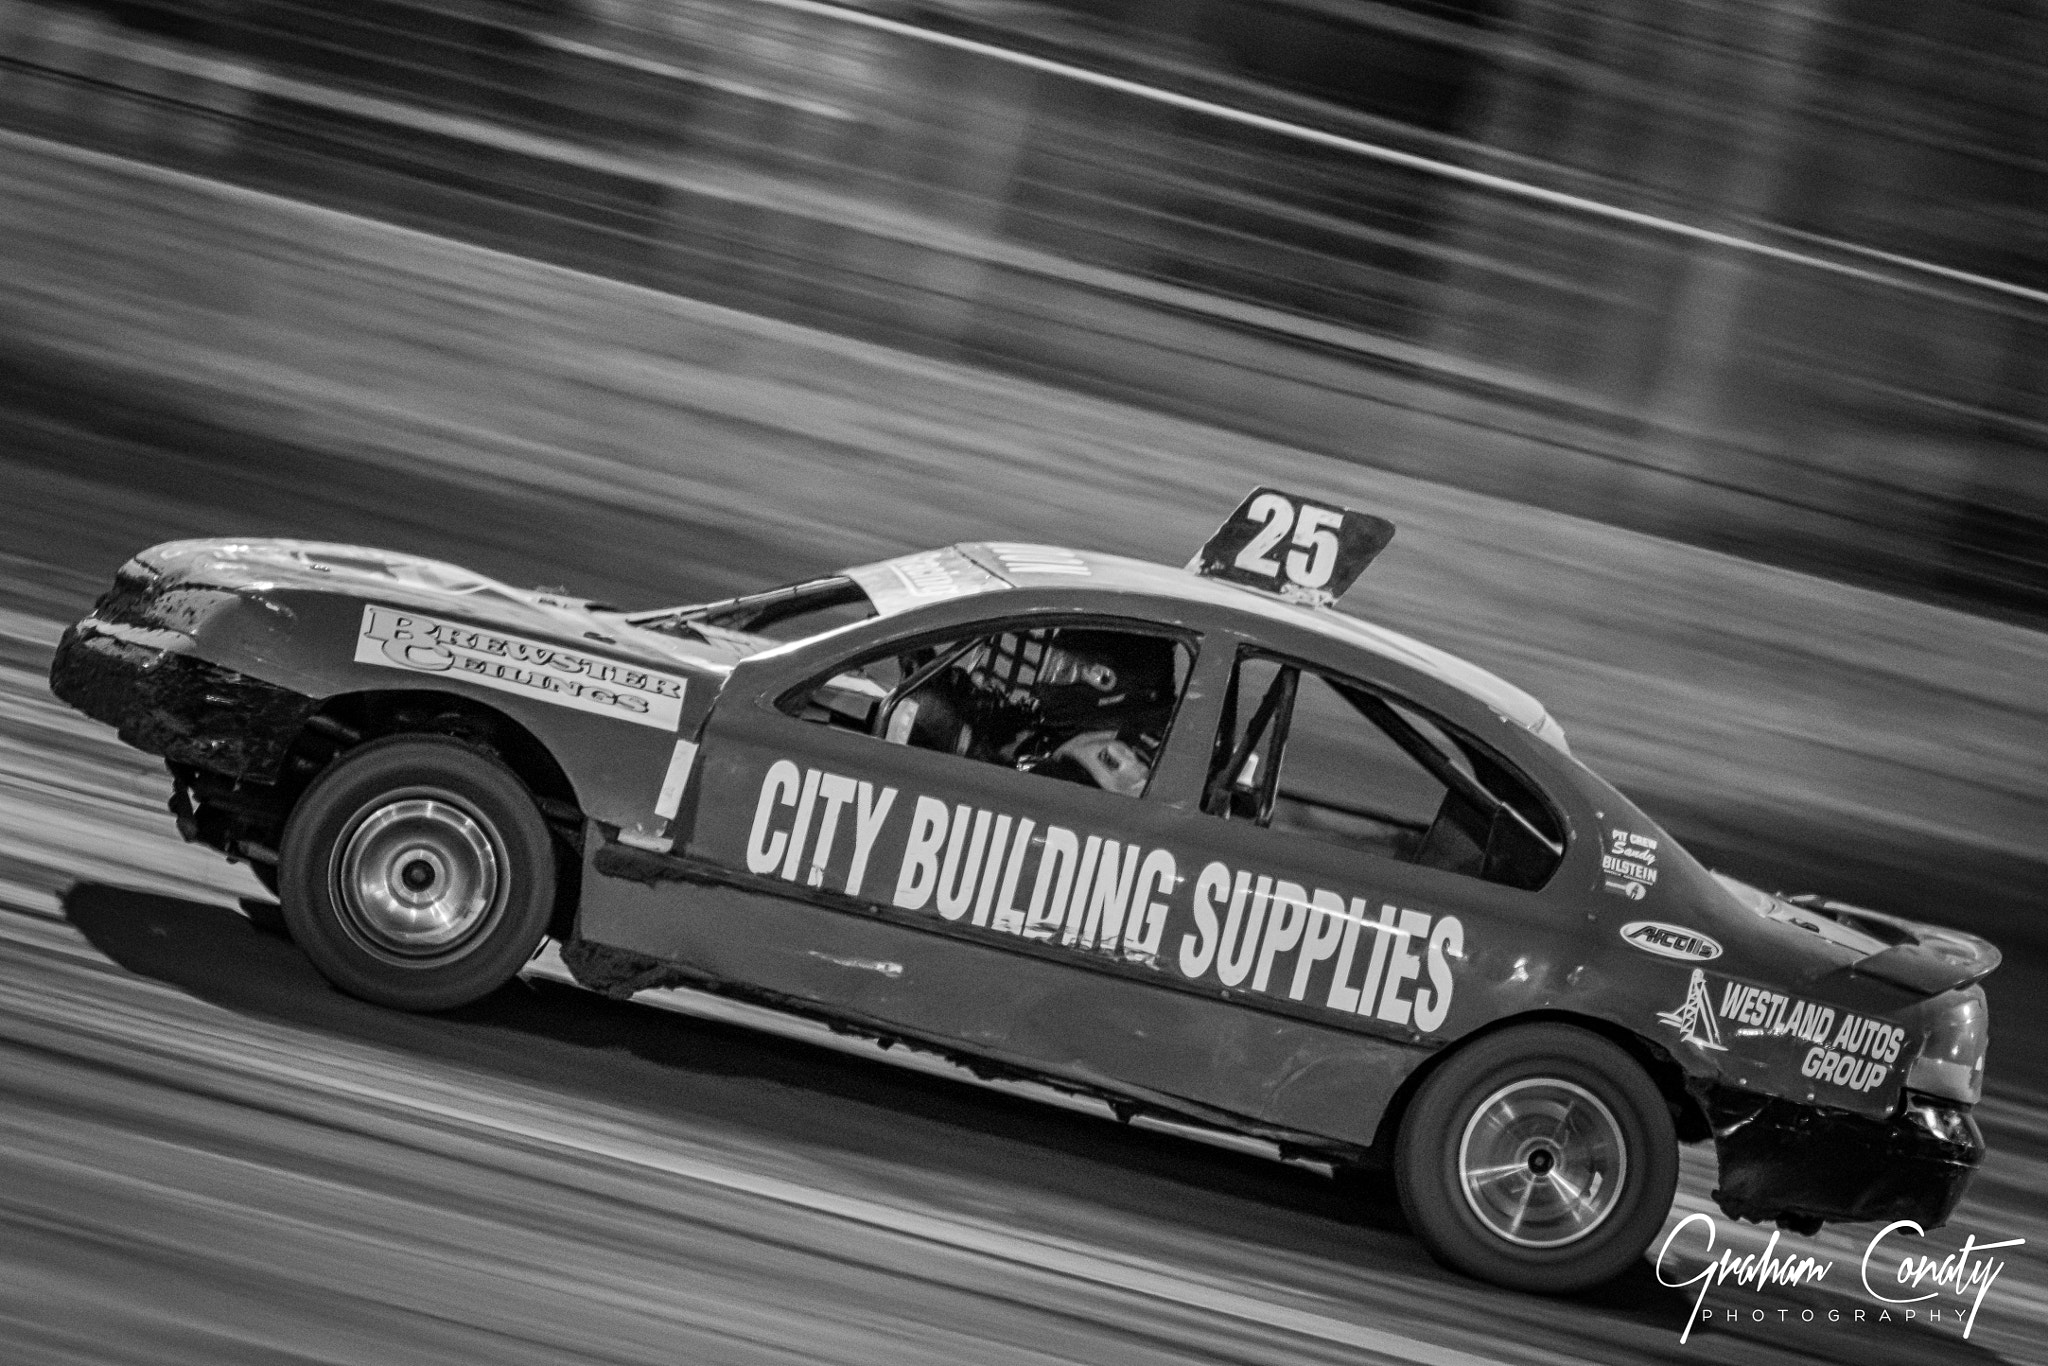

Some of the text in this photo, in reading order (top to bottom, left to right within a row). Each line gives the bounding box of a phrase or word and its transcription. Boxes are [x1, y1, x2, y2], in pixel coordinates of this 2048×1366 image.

[1235, 493, 1346, 588] 25
[364, 607, 682, 699] BREWSTER
[381, 643, 650, 714] CEILINGS
[746, 760, 1466, 1032] CITY BUILDING SUPPLIES
[1602, 855, 1658, 882] BILSTEIN
[1719, 981, 1905, 1063] WESTLAND AUTOS
[1801, 1047, 1887, 1092] GROUP
